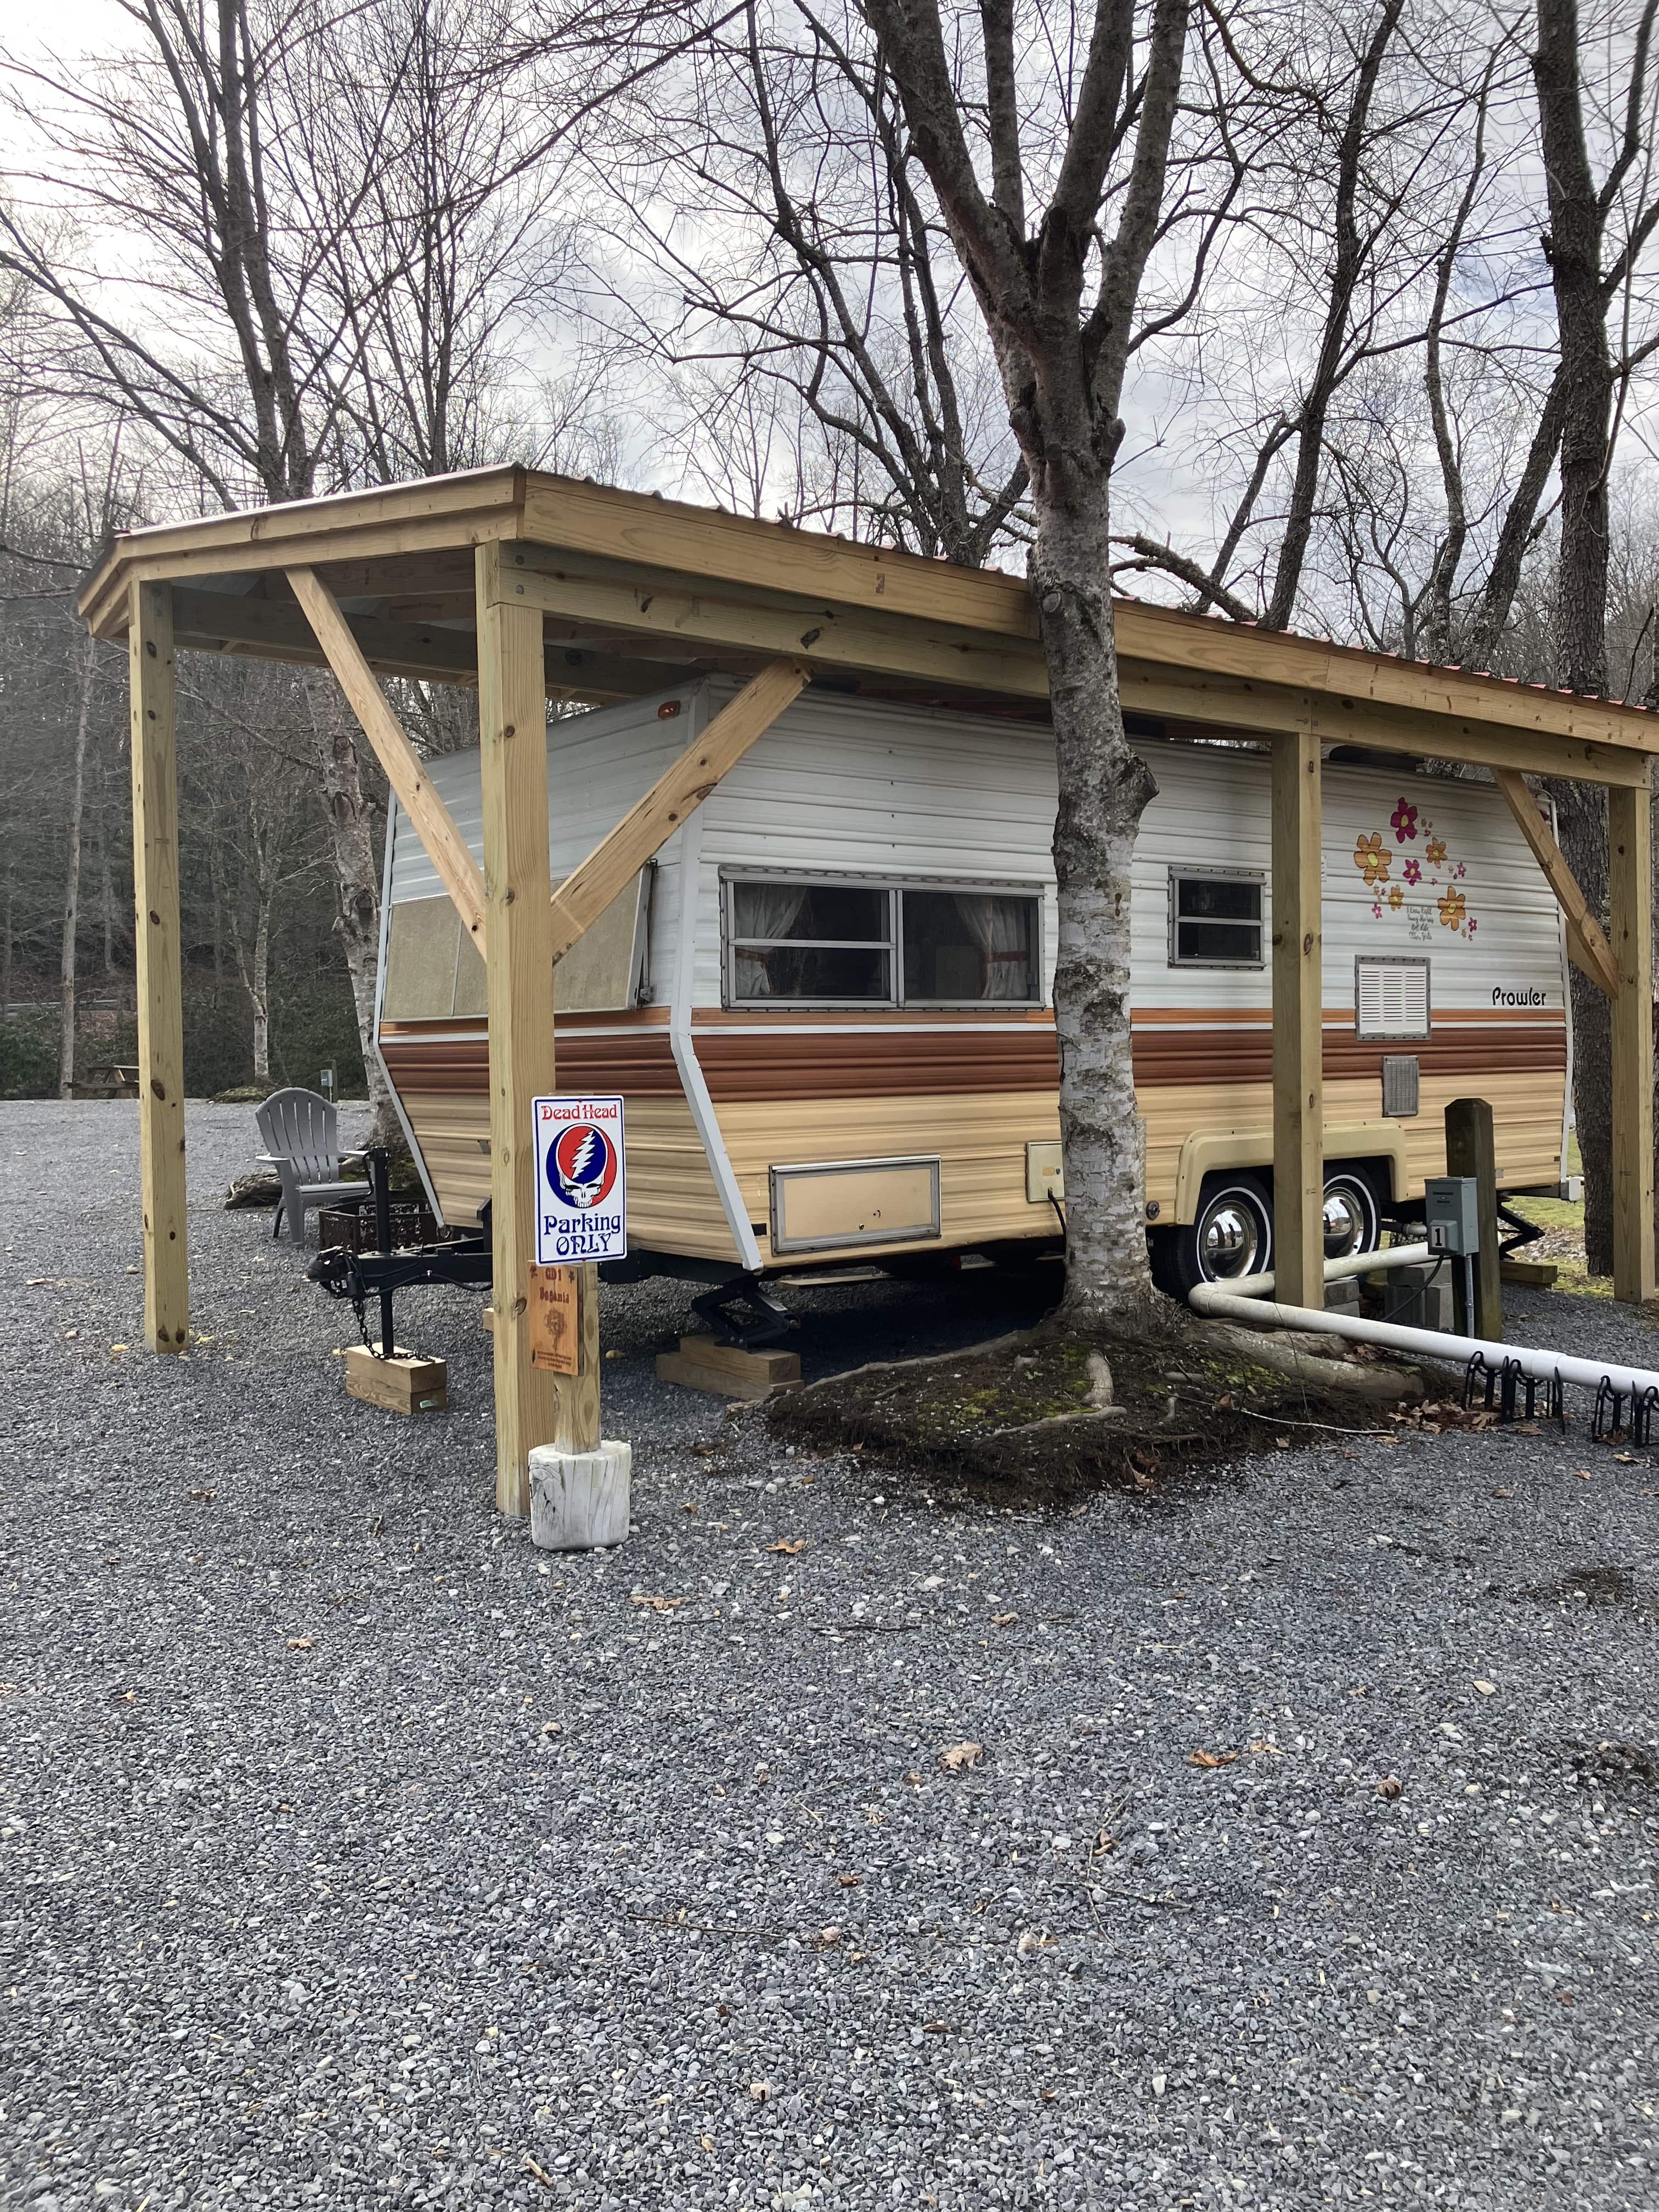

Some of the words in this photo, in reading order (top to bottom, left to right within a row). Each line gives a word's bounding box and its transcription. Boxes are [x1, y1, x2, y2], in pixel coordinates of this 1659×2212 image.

[1492, 986, 1547, 1006] Prowler
[541, 1105, 580, 1120] Dead
[582, 1104, 618, 1119] Head
[544, 1213, 621, 1235] Parking
[556, 1233, 611, 1256] ONLY
[1435, 1228, 1442, 1246] 1
